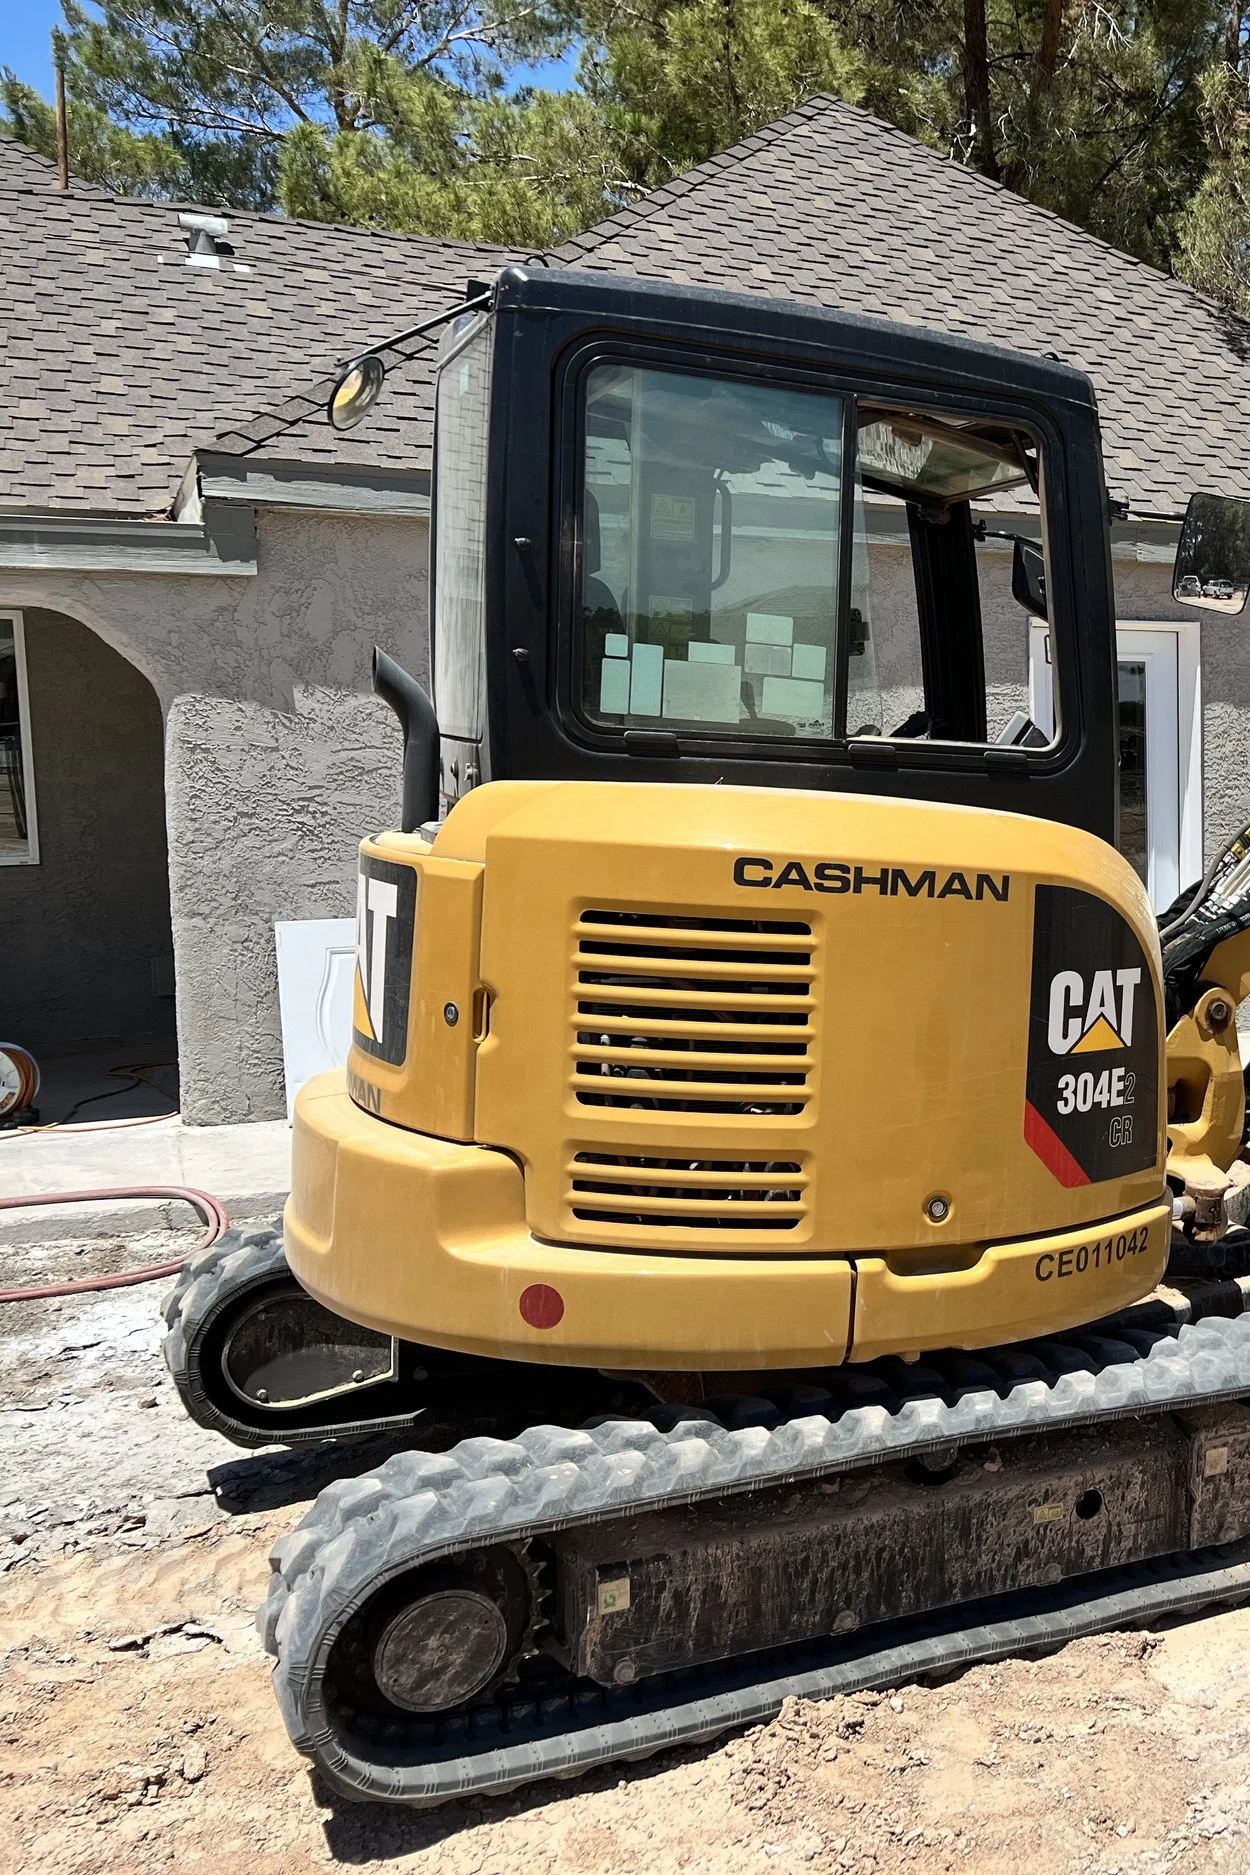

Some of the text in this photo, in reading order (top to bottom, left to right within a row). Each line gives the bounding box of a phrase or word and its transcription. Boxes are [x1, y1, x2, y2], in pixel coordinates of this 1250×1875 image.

[733, 856, 1010, 902] CASHMAN
[1047, 967, 1142, 1055] CAT
[1056, 1066, 1136, 1115] 304E2
[1108, 1115, 1134, 1148] CR
[1035, 1226, 1149, 1281] CE011042
